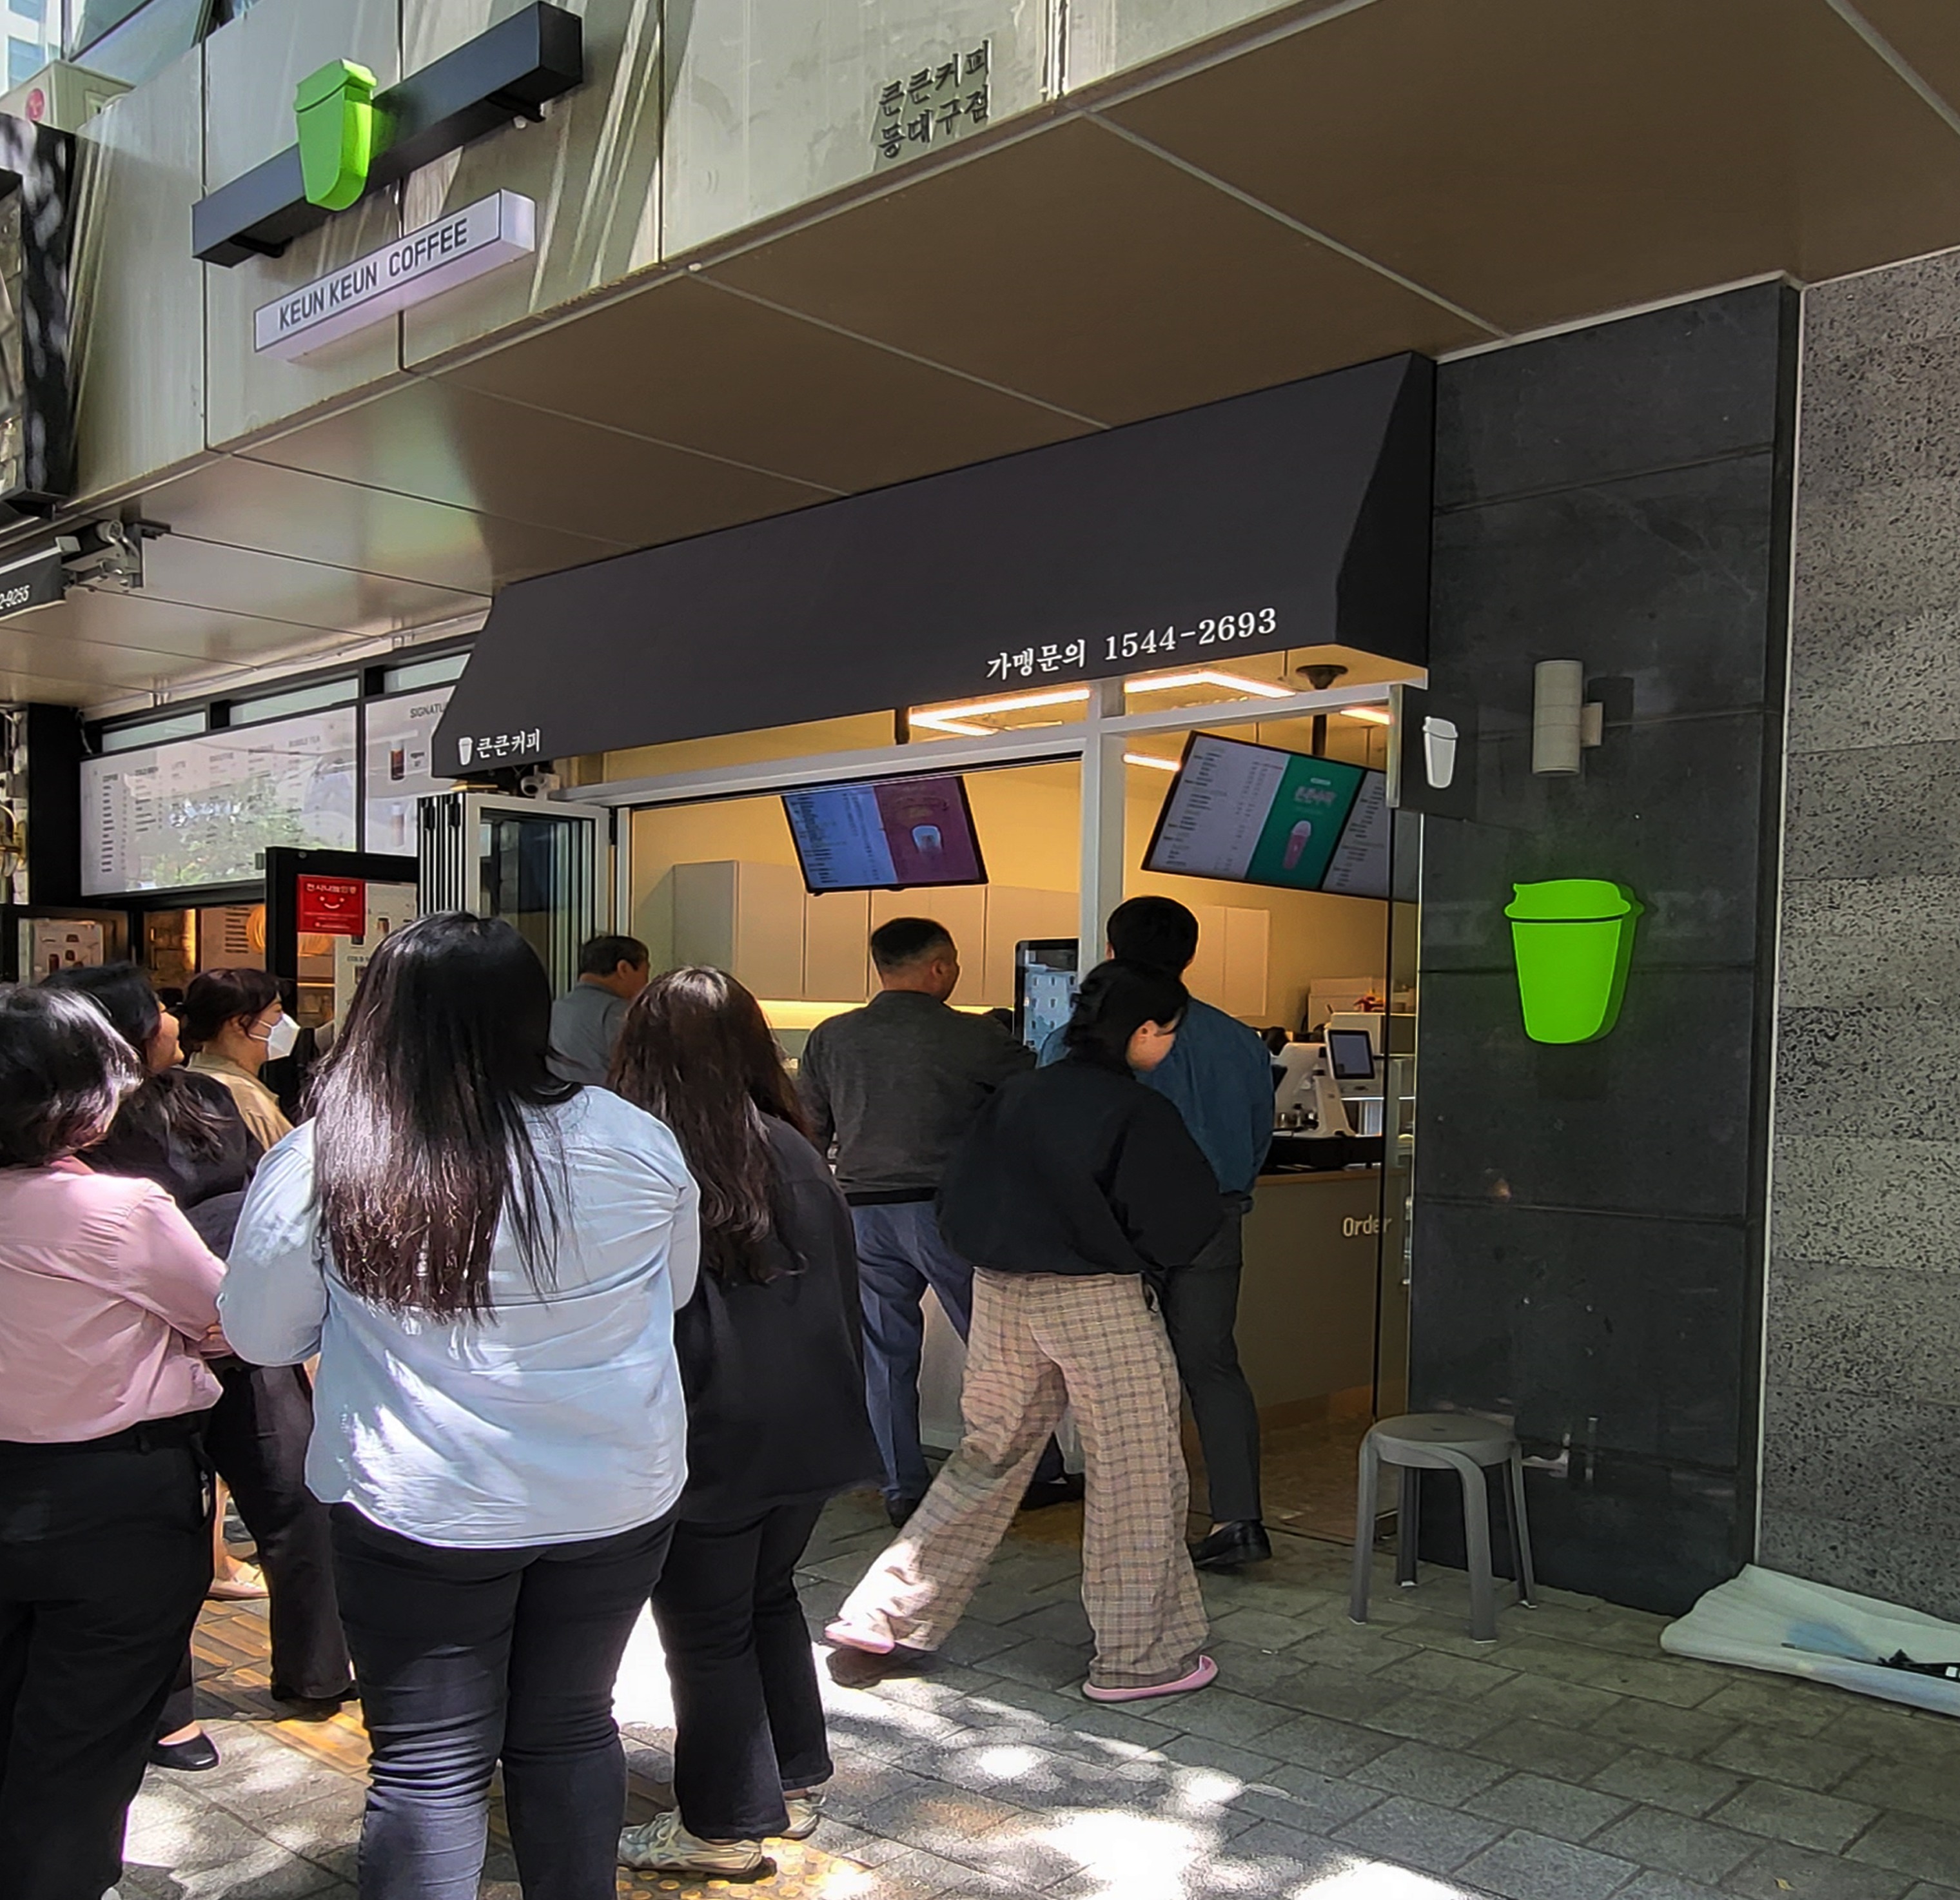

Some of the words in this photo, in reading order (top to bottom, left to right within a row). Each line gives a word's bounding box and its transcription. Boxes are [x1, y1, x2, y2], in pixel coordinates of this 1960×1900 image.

[879, 39, 989, 117] 큰큰커피
[279, 286, 324, 331] KEUN
[329, 262, 378, 307] KEUN
[389, 218, 467, 278] COFFEE
[986, 639, 1086, 681] 가맹문의
[1104, 607, 1277, 661] 1544-2693
[476, 728, 540, 759] 큰큰커피
[1343, 1214, 1393, 1237] Order
